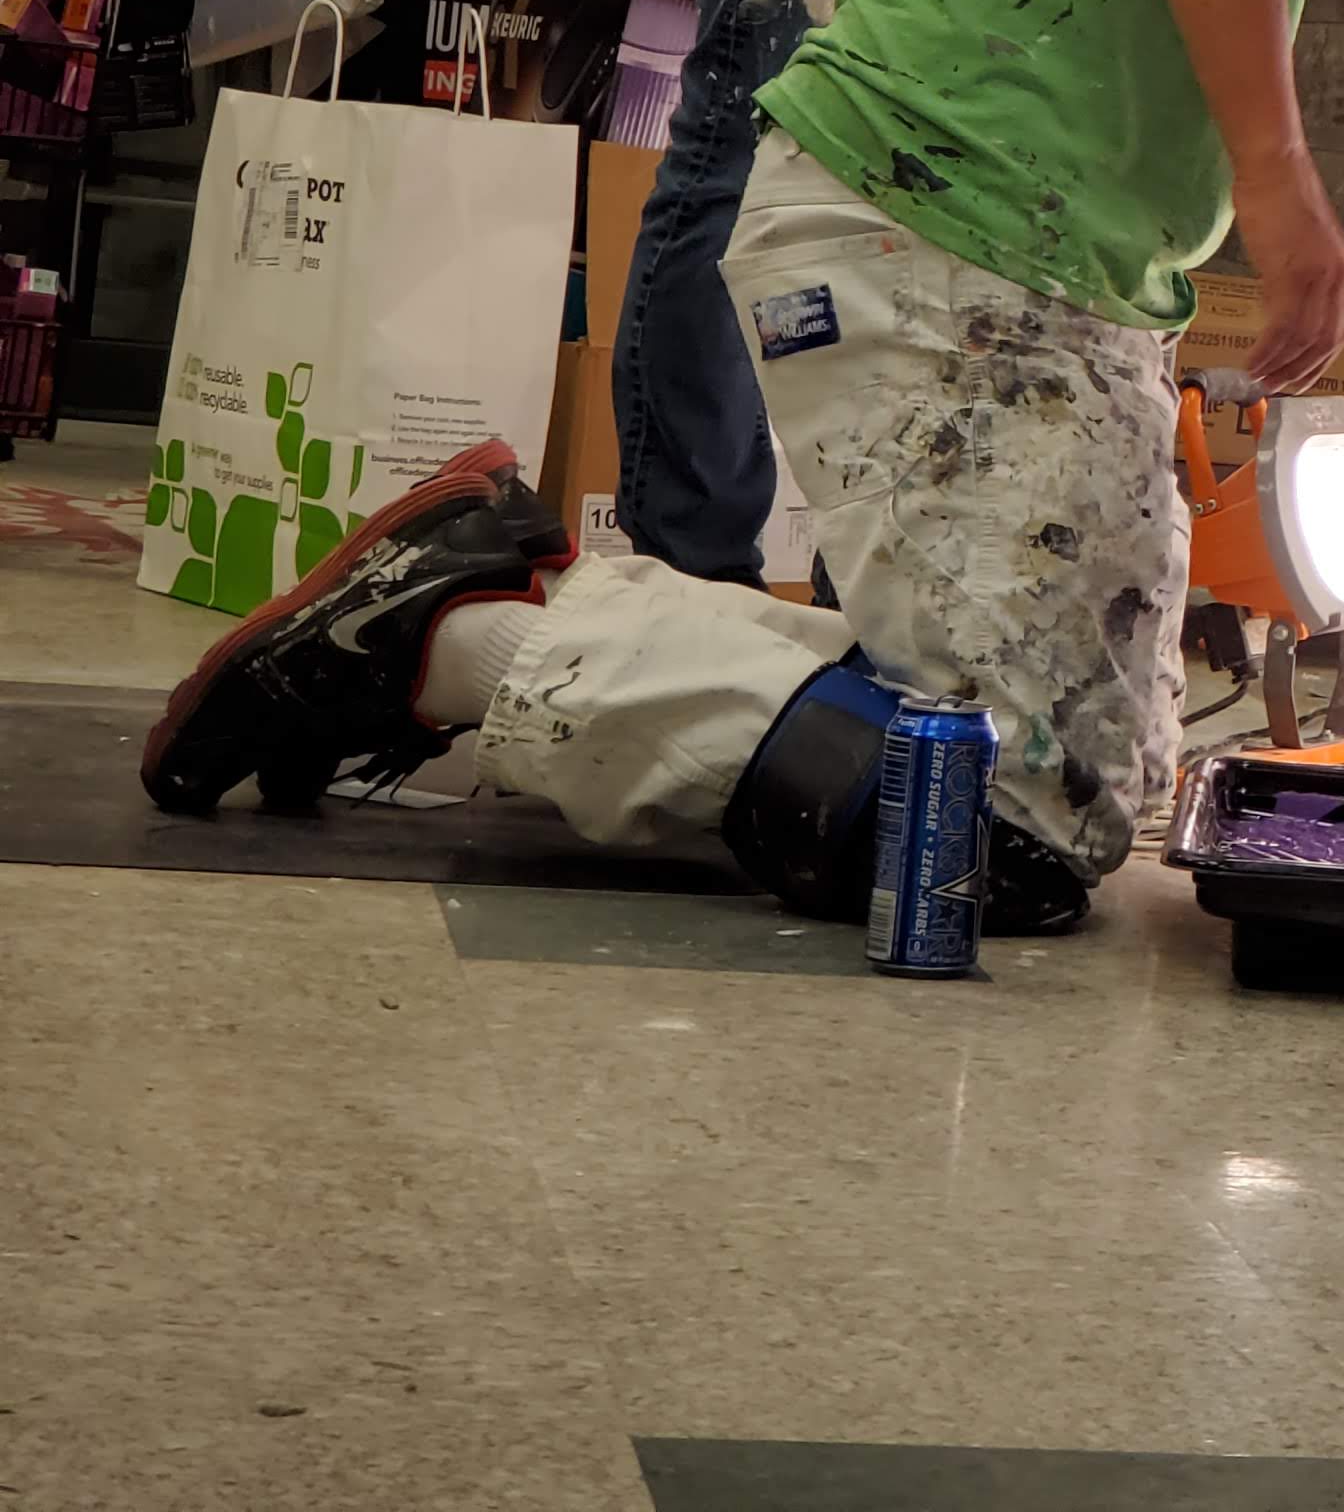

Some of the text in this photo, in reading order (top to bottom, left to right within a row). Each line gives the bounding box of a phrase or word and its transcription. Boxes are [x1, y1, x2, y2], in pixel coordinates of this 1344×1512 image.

[490, 12, 544, 41] KEURIG
[424, 68, 476, 96] ING
[931, 742, 945, 780] ZERO
[926, 781, 941, 831] SUGAR
[920, 848, 934, 889] ZERO
